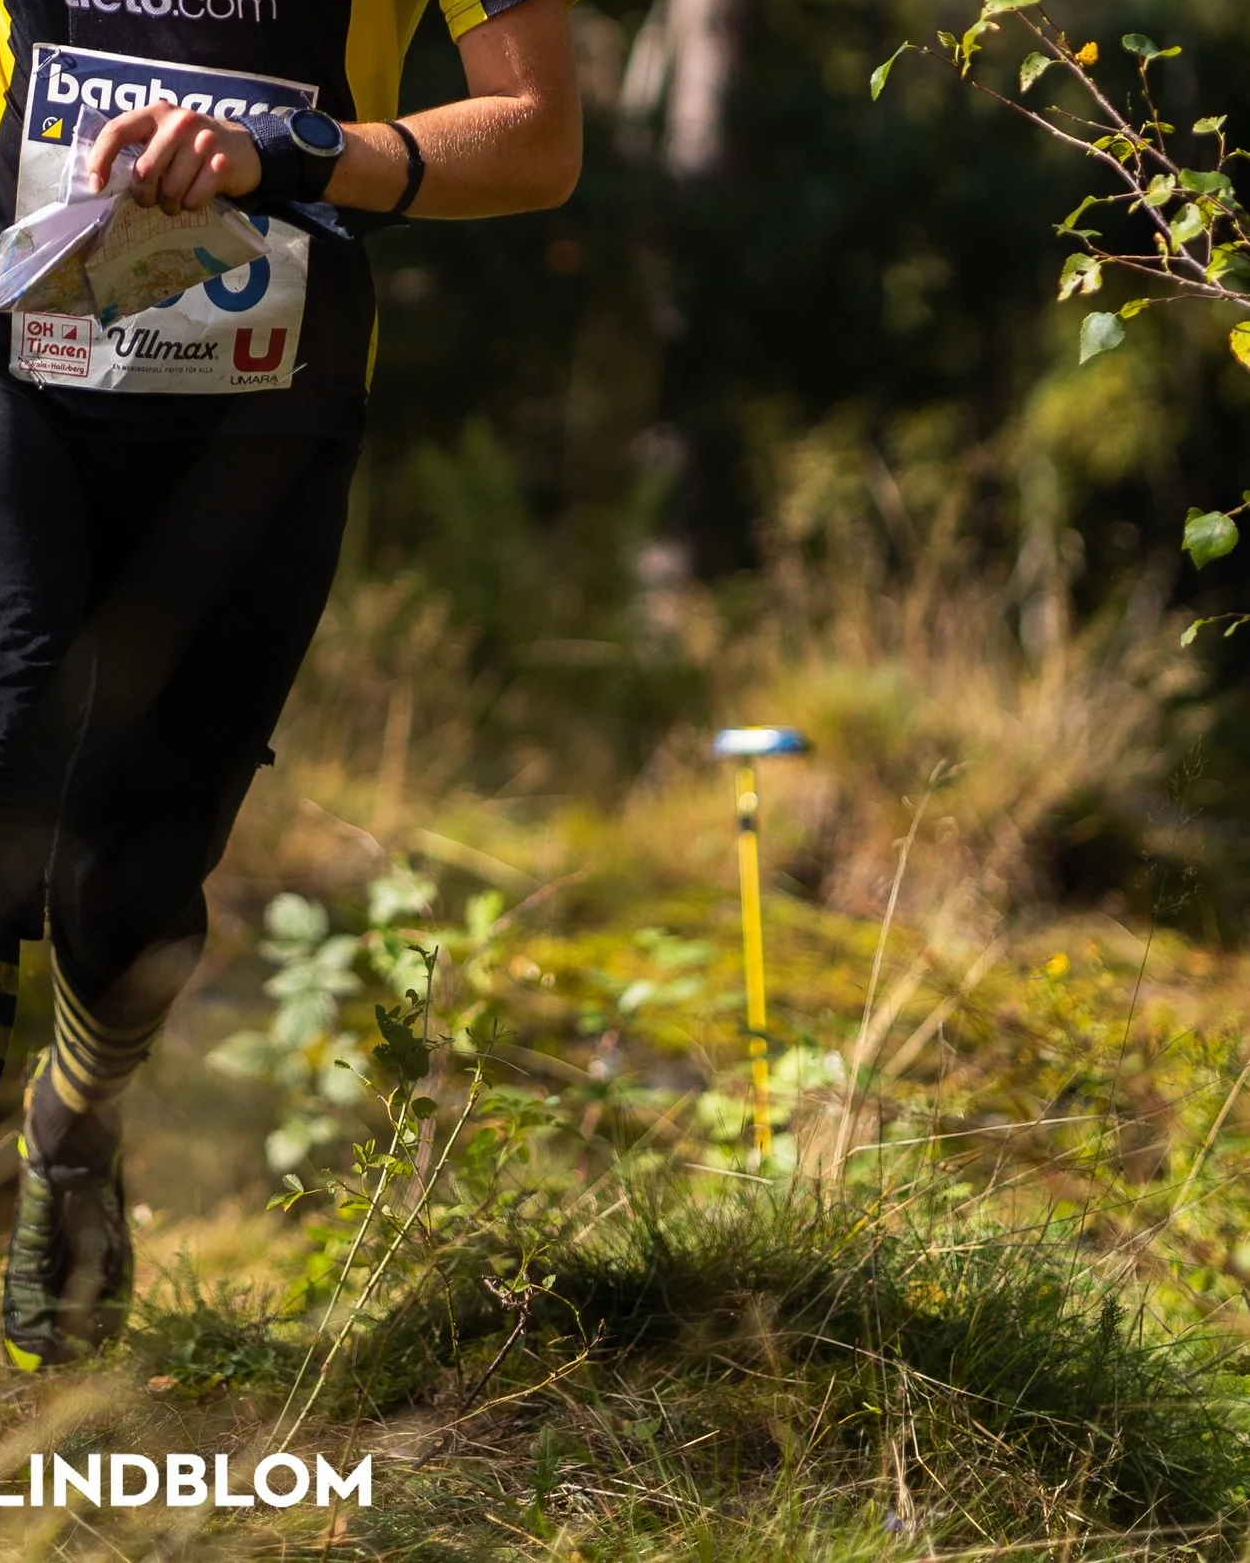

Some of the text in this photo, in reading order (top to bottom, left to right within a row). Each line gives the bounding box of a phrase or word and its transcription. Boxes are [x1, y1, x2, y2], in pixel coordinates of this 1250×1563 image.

[47, 63, 298, 122] baghee
[27, 338, 87, 359] Tisaren
[107, 326, 218, 359] Ullmax
[51, 362, 85, 375] Hallsberg
[230, 374, 278, 385] UMARA
